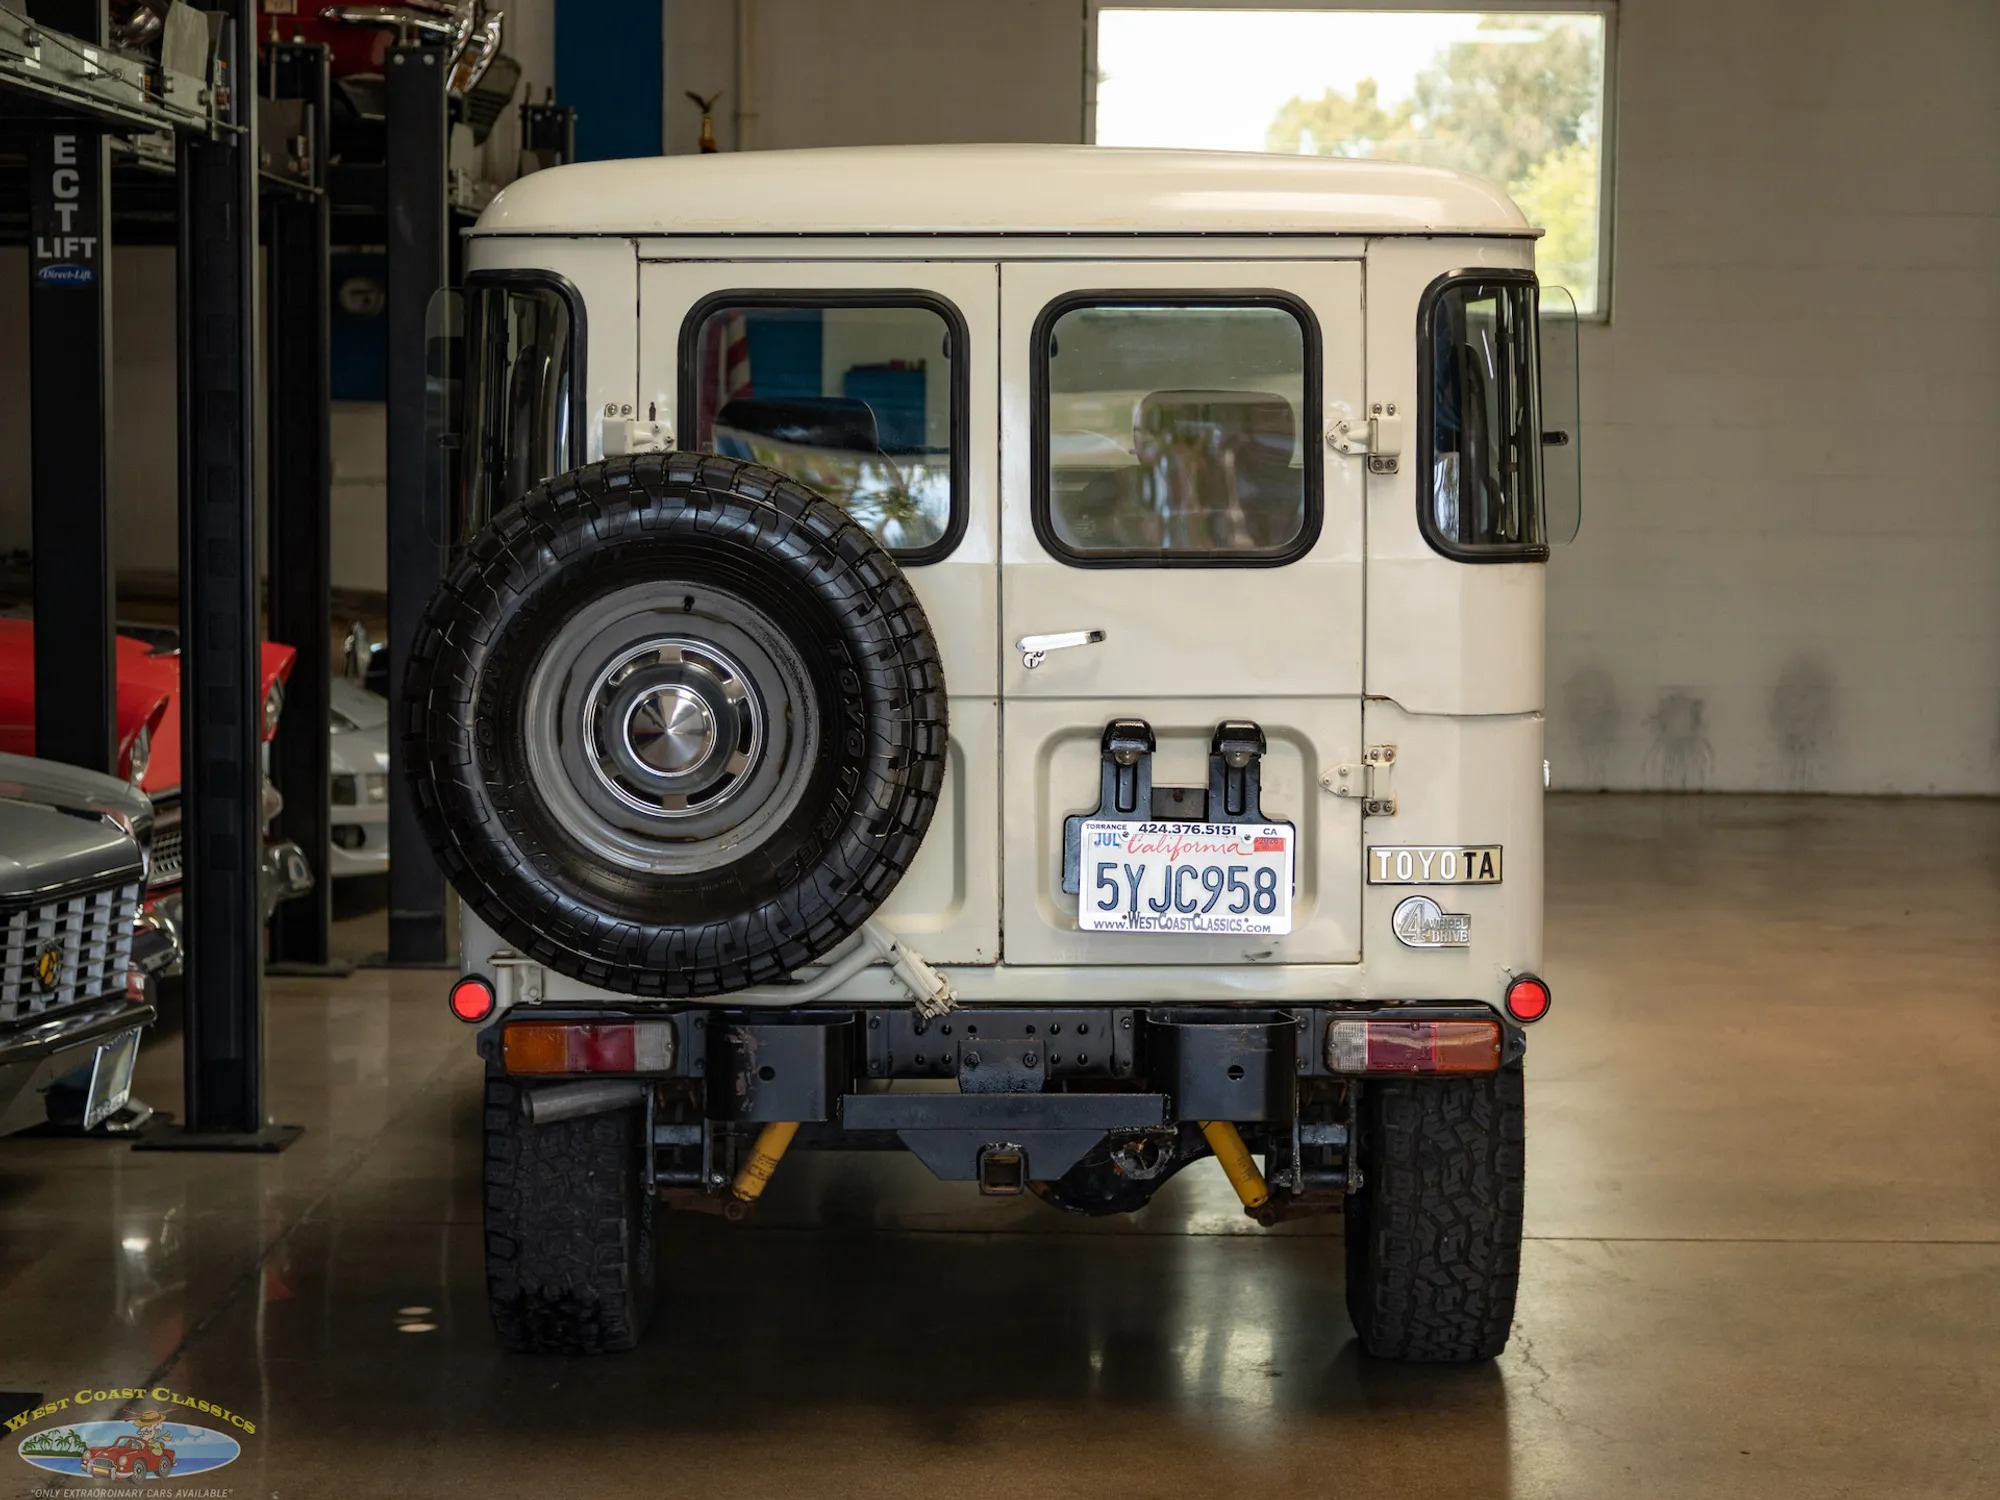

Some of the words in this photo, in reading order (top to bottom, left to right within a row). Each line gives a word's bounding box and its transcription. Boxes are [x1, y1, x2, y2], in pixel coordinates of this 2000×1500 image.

[36, 236, 98, 258] LIFT
[41, 266, 94, 281] Direct-Lift
[827, 639, 866, 758] TOYO
[1086, 823, 1128, 832] TORRANCE
[1138, 823, 1237, 836] 424.376.5151
[1262, 827, 1278, 836] CA
[1093, 833, 1121, 848] JUL
[1127, 834, 1253, 862] California
[1376, 851, 1495, 880] TOYOTA
[1096, 862, 1278, 915] 5YJC958
[1401, 901, 1426, 942] 4
[1427, 917, 1469, 930] WHEEL
[1430, 930, 1469, 943] DRIVE
